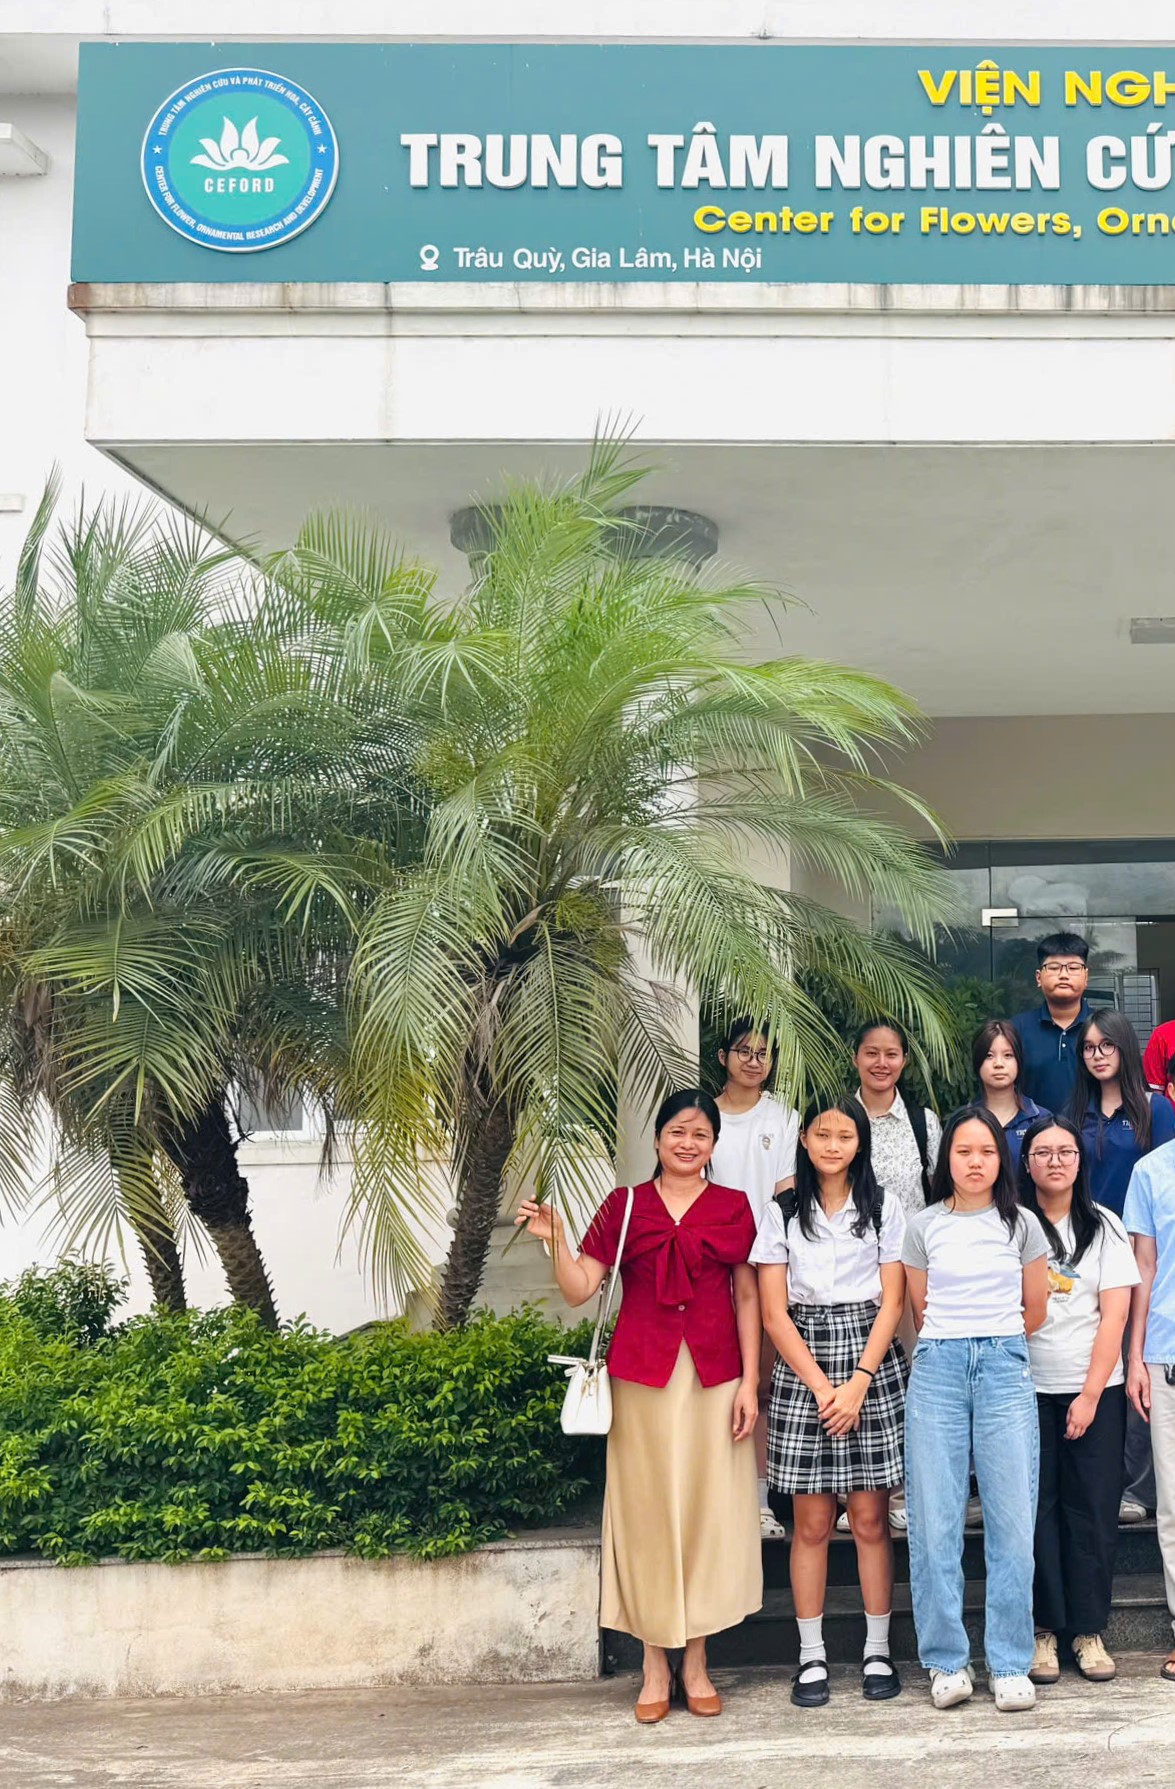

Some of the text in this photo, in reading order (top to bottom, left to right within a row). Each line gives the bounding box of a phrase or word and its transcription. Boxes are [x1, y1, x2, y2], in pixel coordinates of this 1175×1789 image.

[918, 59, 1040, 116] VIỆN
[400, 133, 623, 188] TRUNG
[647, 121, 789, 189] TÂM
[815, 123, 1060, 190] NGHIÊN
[196, 223, 245, 240] ORNAMENTAL
[245, 220, 285, 240] RESEARCH
[294, 167, 324, 216] DEVELOPMENT
[204, 177, 274, 193] CEFORD
[693, 205, 834, 233] Center
[849, 206, 906, 233] for
[920, 206, 1082, 239] Flowers,
[453, 247, 762, 273] Trâu Quỳ, Gia Lâm, Hà Nội
